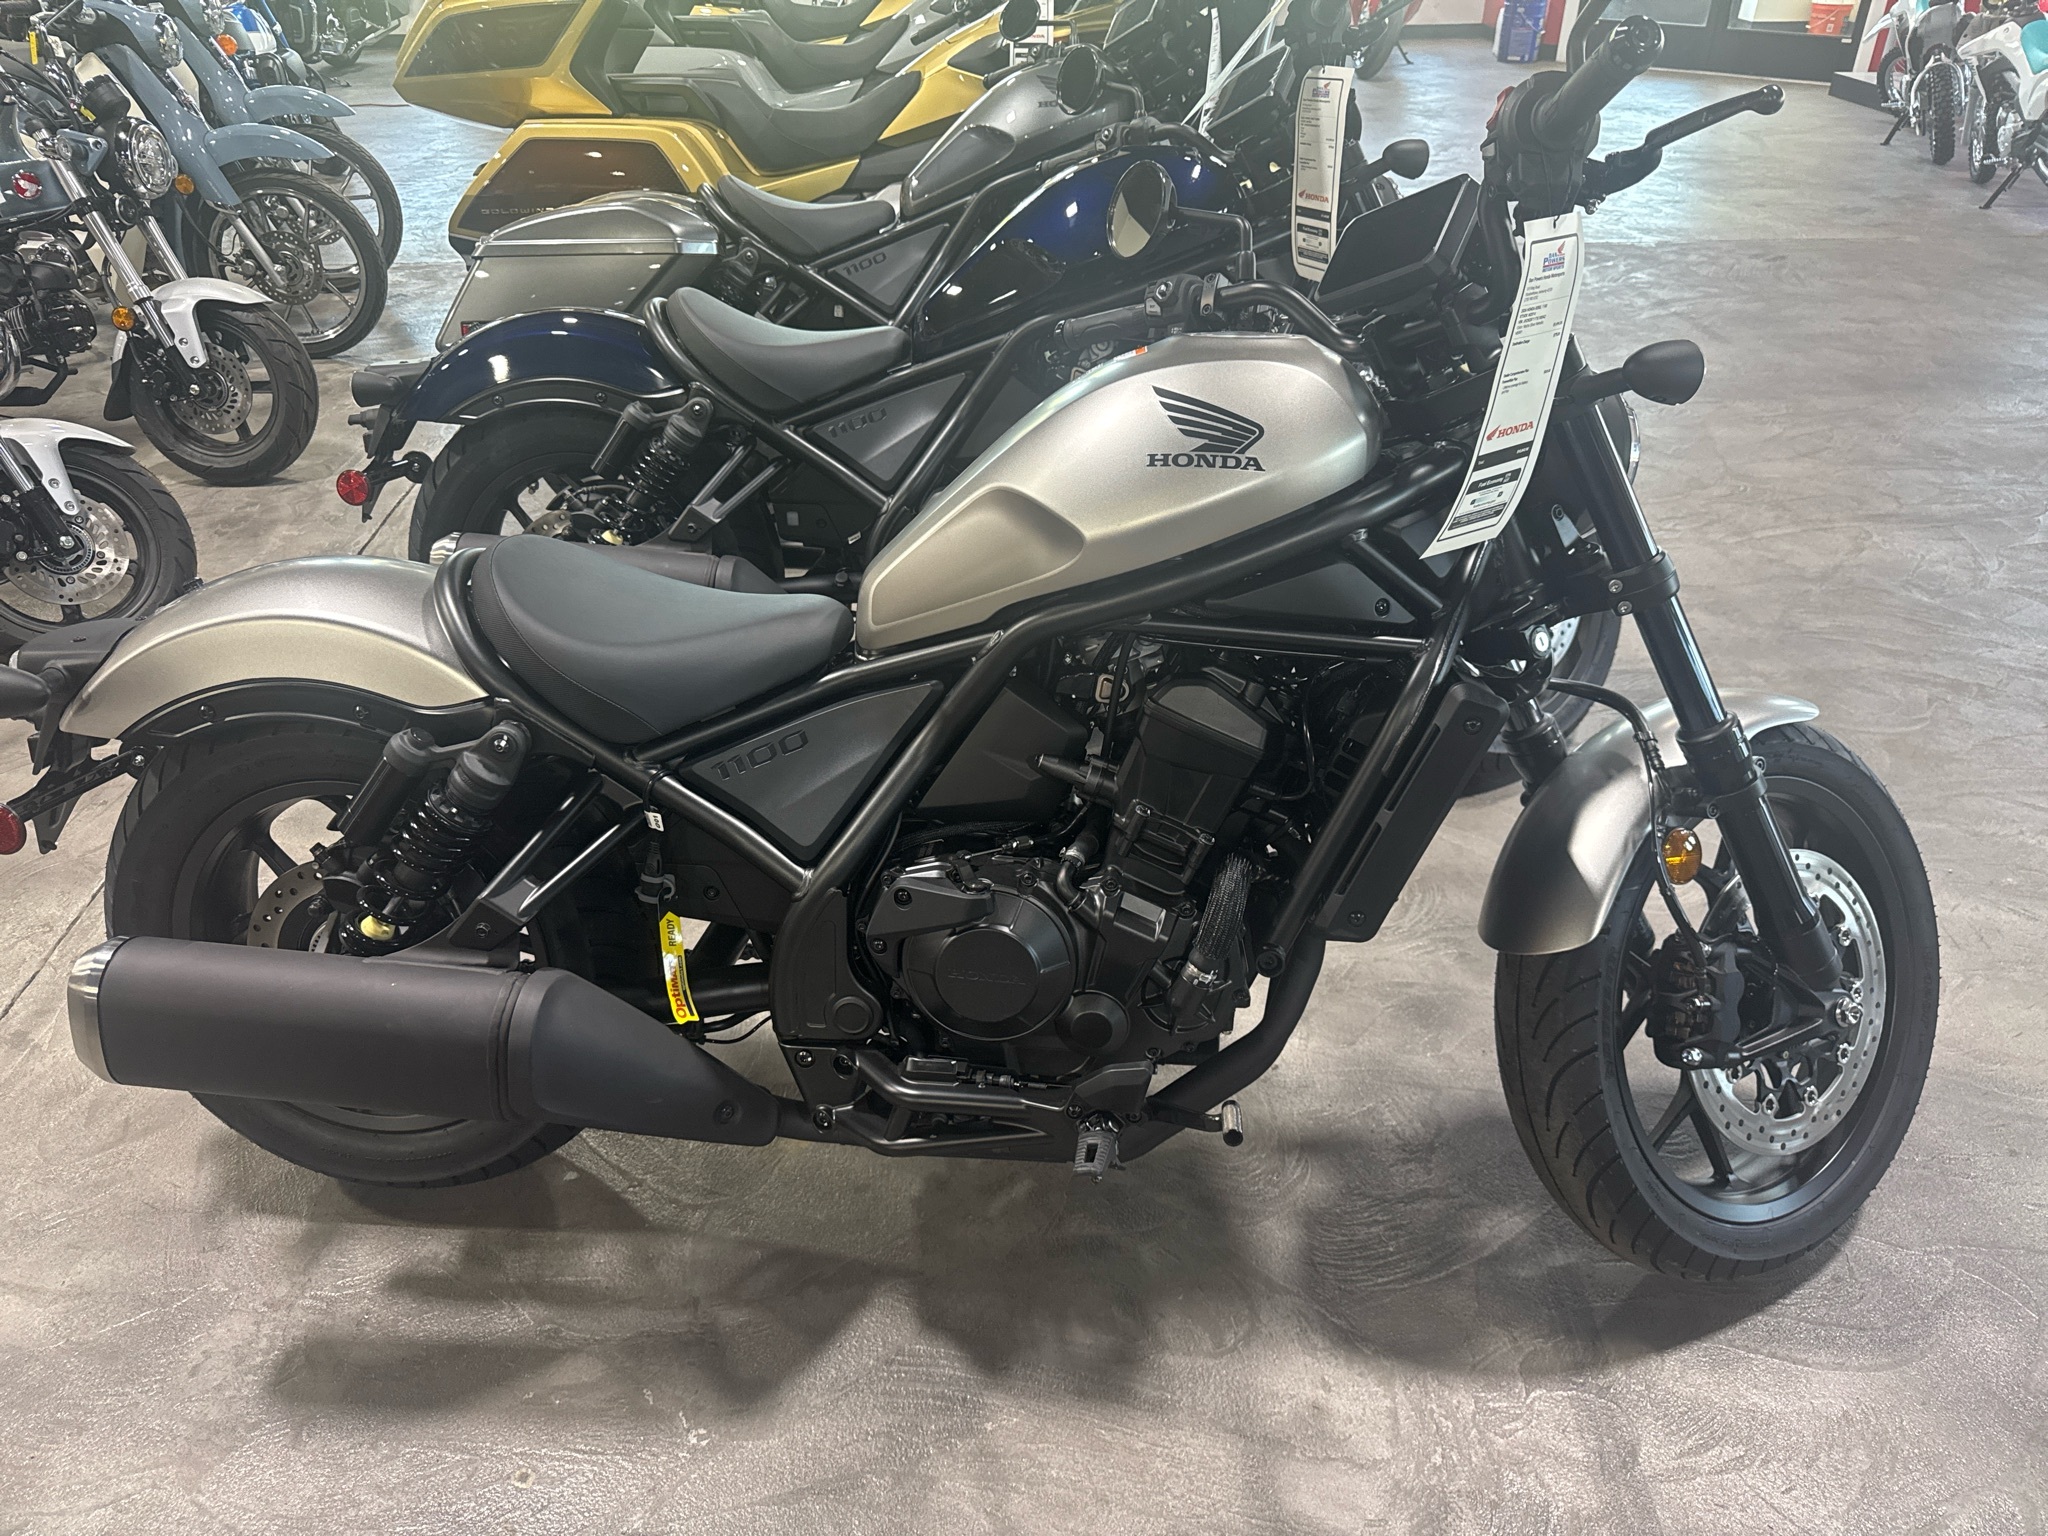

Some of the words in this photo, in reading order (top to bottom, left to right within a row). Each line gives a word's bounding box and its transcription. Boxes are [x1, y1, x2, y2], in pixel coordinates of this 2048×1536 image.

[1305, 193, 1329, 203] HONDA
[843, 252, 887, 276] 1100
[828, 408, 887, 438] 1100
[1496, 420, 1534, 438] HONDA
[1146, 453, 1266, 472] HONDA
[711, 729, 809, 780] 1100
[667, 918, 677, 947] READY
